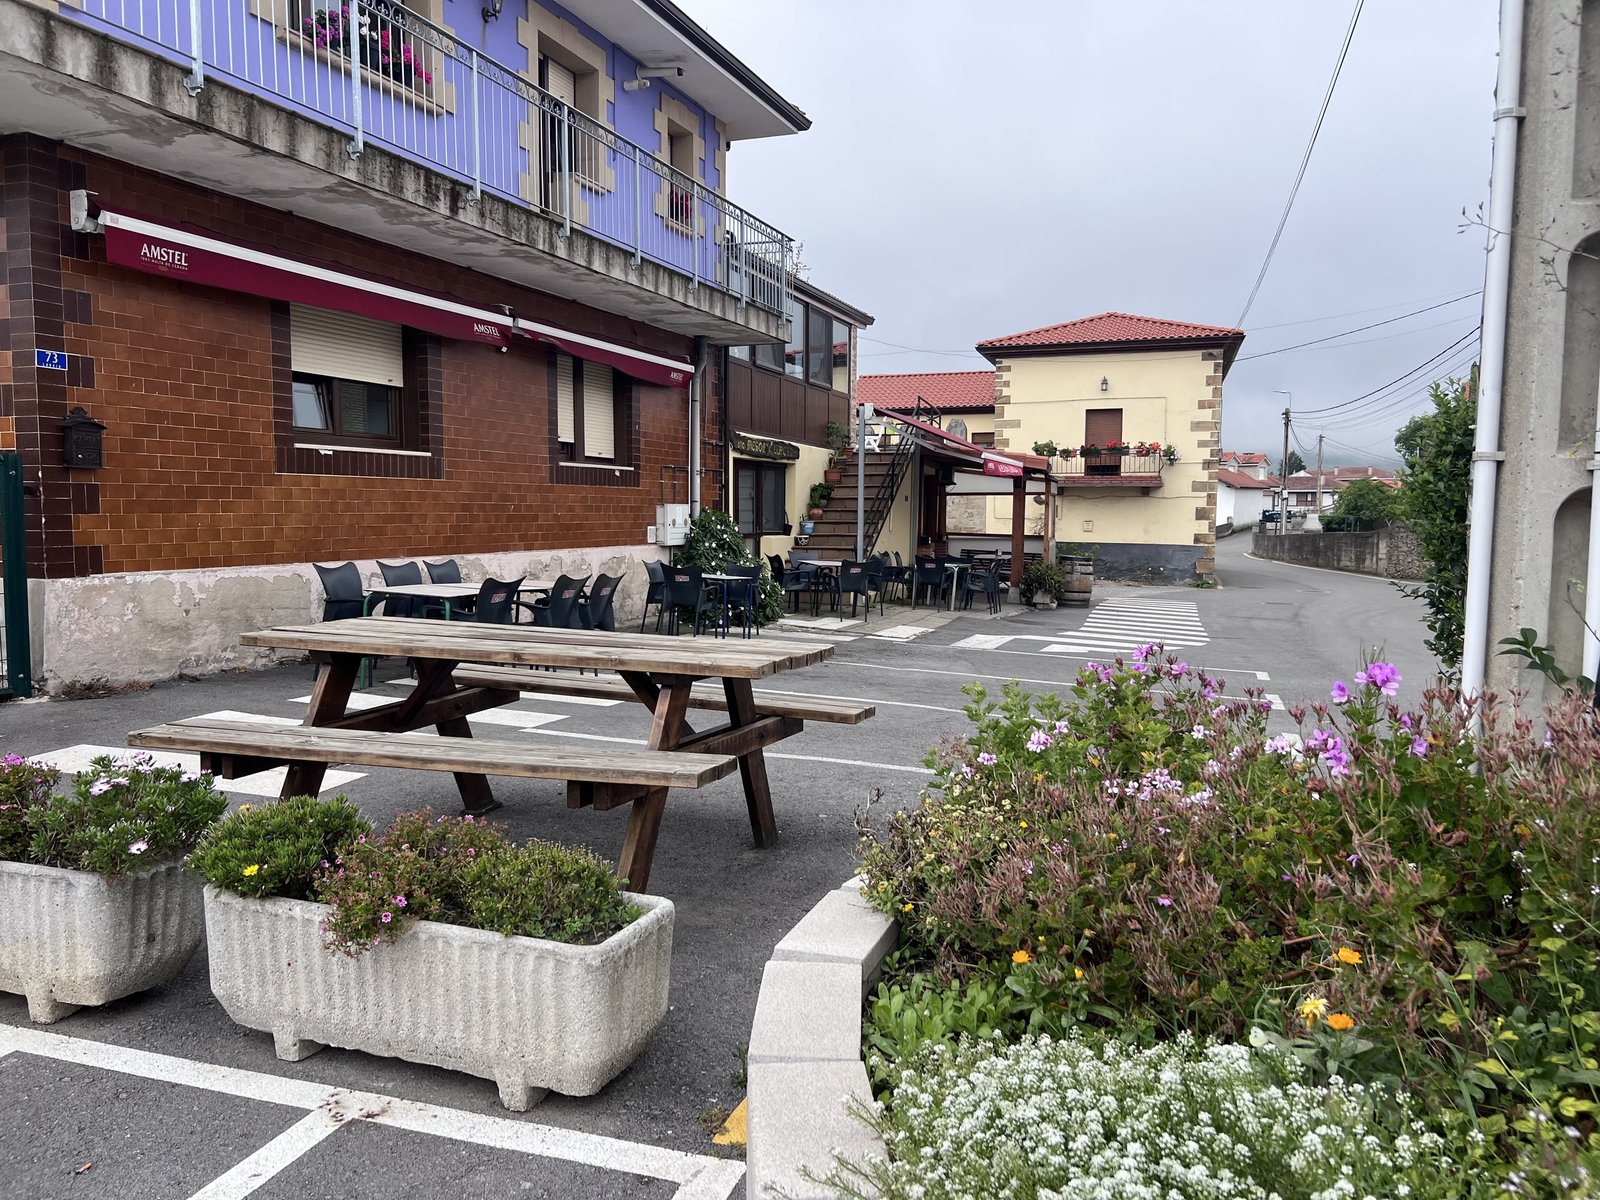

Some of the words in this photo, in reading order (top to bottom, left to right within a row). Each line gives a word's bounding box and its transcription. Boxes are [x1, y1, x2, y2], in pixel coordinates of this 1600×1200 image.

[140, 243, 188, 266] AMSTEL
[473, 323, 500, 337] AMSTEL
[45, 351, 58, 364] 73
